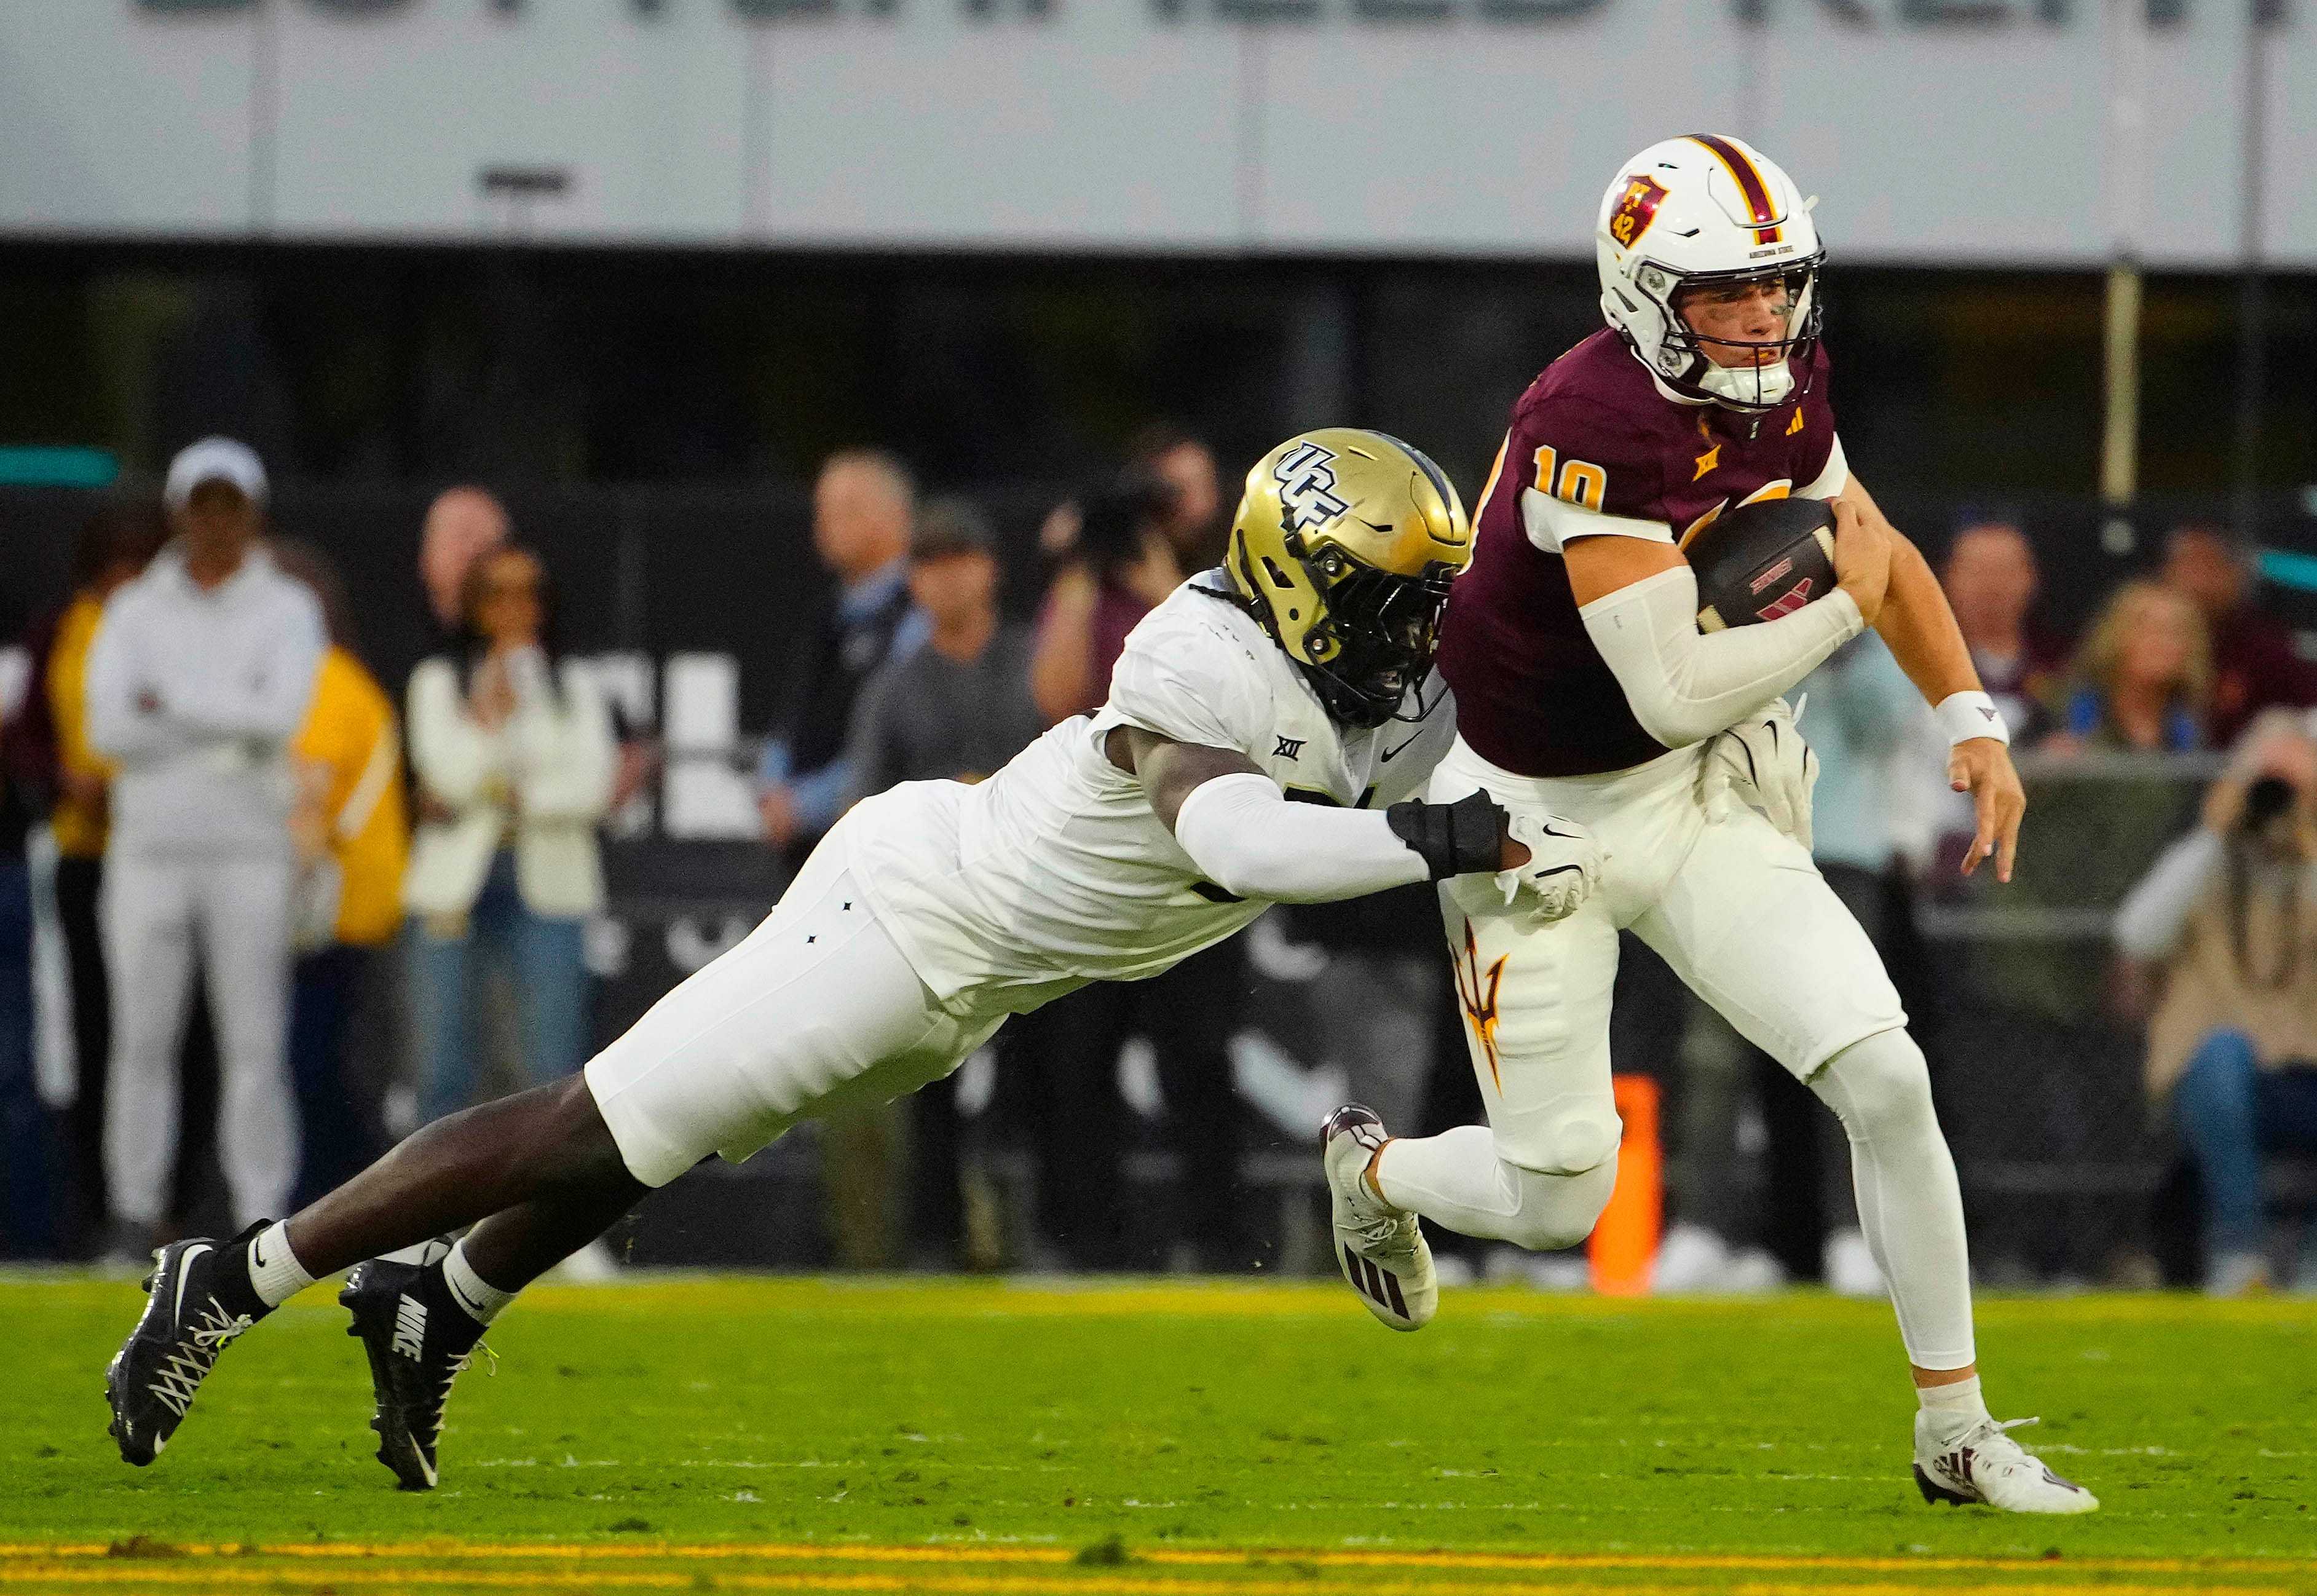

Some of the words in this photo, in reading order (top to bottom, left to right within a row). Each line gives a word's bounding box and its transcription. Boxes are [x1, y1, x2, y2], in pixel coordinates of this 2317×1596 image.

[1273, 441, 1351, 531] UCF
[1533, 444, 1608, 513] 10
[392, 1293, 428, 1362] NIKE
